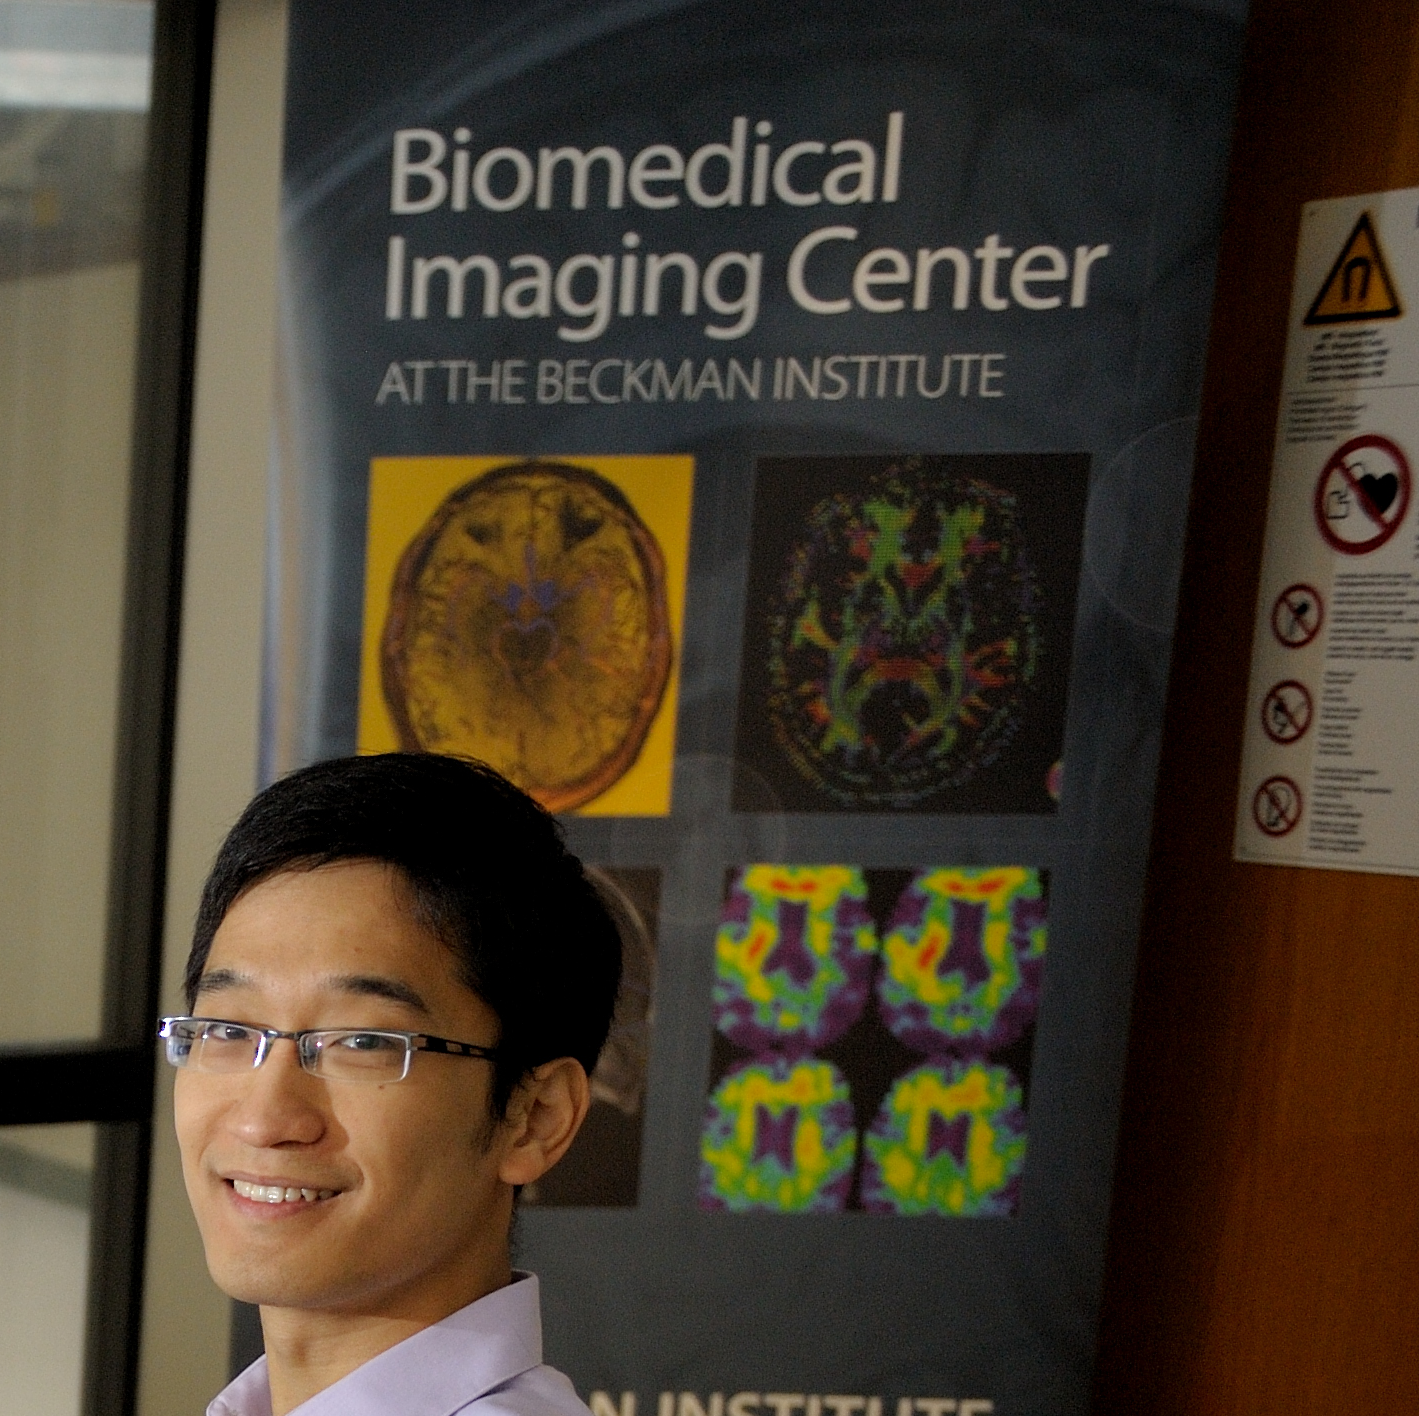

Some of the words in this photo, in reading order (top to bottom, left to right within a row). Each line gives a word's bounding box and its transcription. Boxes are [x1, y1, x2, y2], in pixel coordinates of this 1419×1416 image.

[388, 111, 905, 217] Biomedical
[383, 230, 763, 341] Imaging
[785, 226, 1110, 316] Center
[375, 361, 442, 404] AT
[443, 358, 528, 402] THE
[535, 357, 764, 402] BECKMAN
[772, 353, 1008, 399] INSTITUTE
